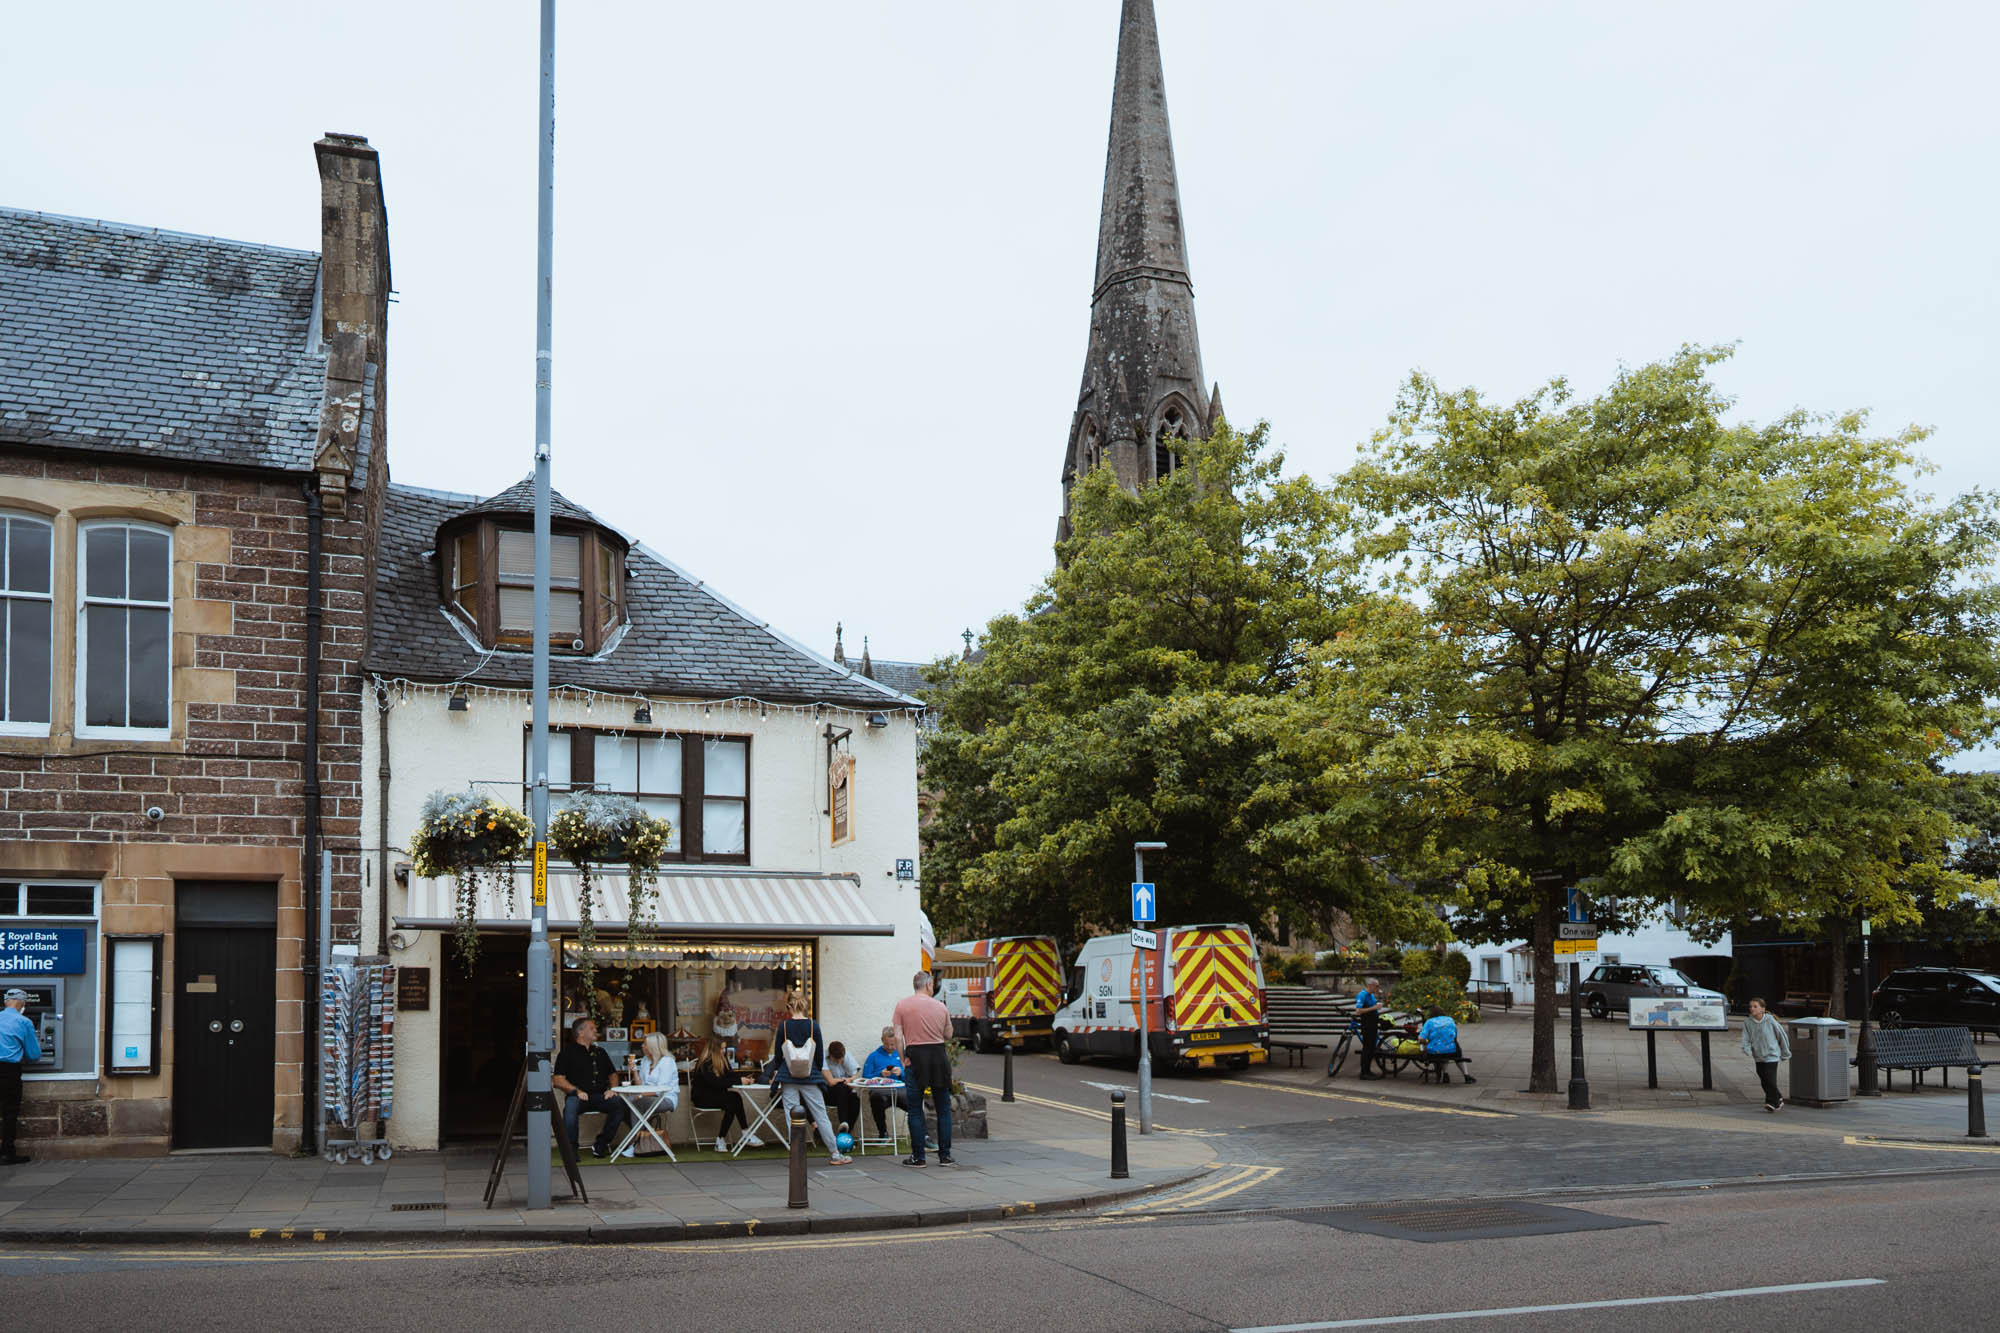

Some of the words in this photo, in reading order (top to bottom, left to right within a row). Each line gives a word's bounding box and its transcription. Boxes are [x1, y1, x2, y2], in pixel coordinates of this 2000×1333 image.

[8, 932, 33, 942] Royal
[35, 932, 58, 940] Bank
[1562, 928, 1578, 936] One
[1580, 928, 1595, 936] way
[1133, 932, 1144, 943] One
[1145, 937, 1155, 946] way
[20, 943, 58, 951] Scotland
[0, 955, 54, 970] ashline
[1099, 985, 1112, 997] SGN
